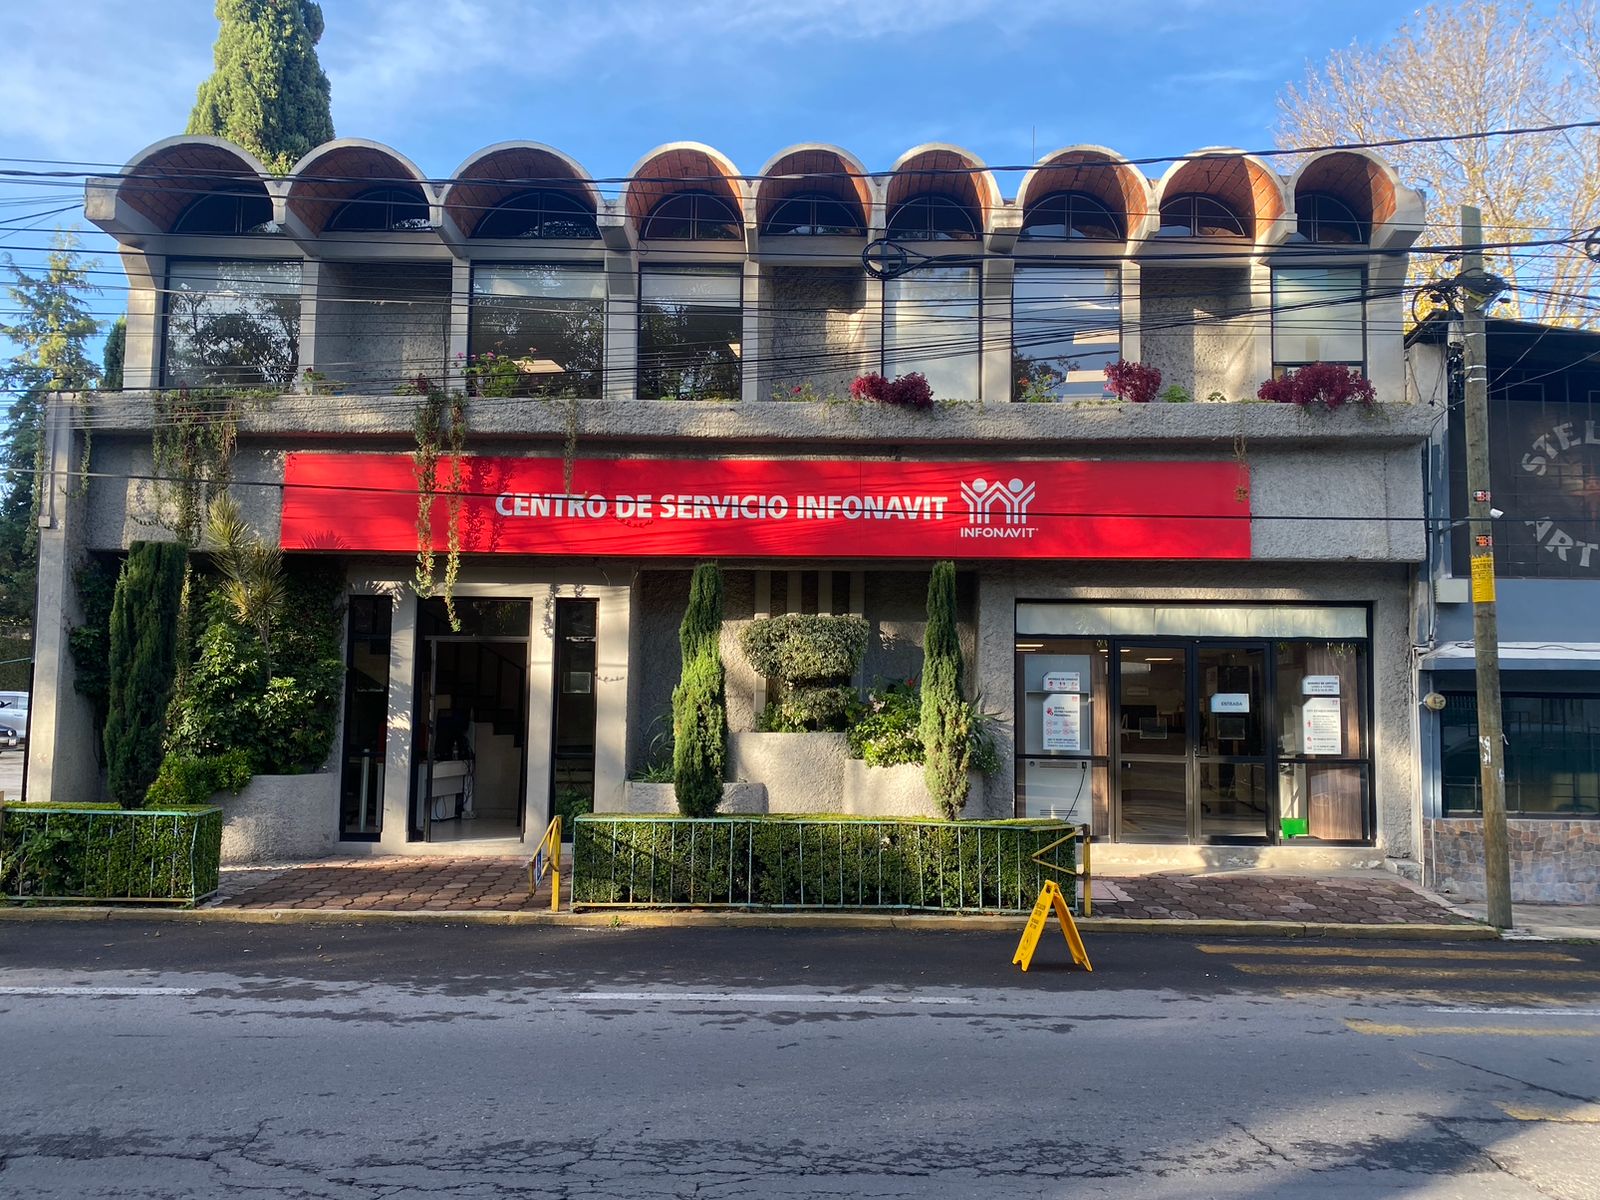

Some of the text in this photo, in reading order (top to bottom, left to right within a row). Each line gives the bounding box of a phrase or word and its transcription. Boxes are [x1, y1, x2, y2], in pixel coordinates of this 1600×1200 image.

[495, 493, 948, 520] CENTRO DE SERVICIO INFONAVIT
[960, 527, 1035, 539] INFONAVIT
